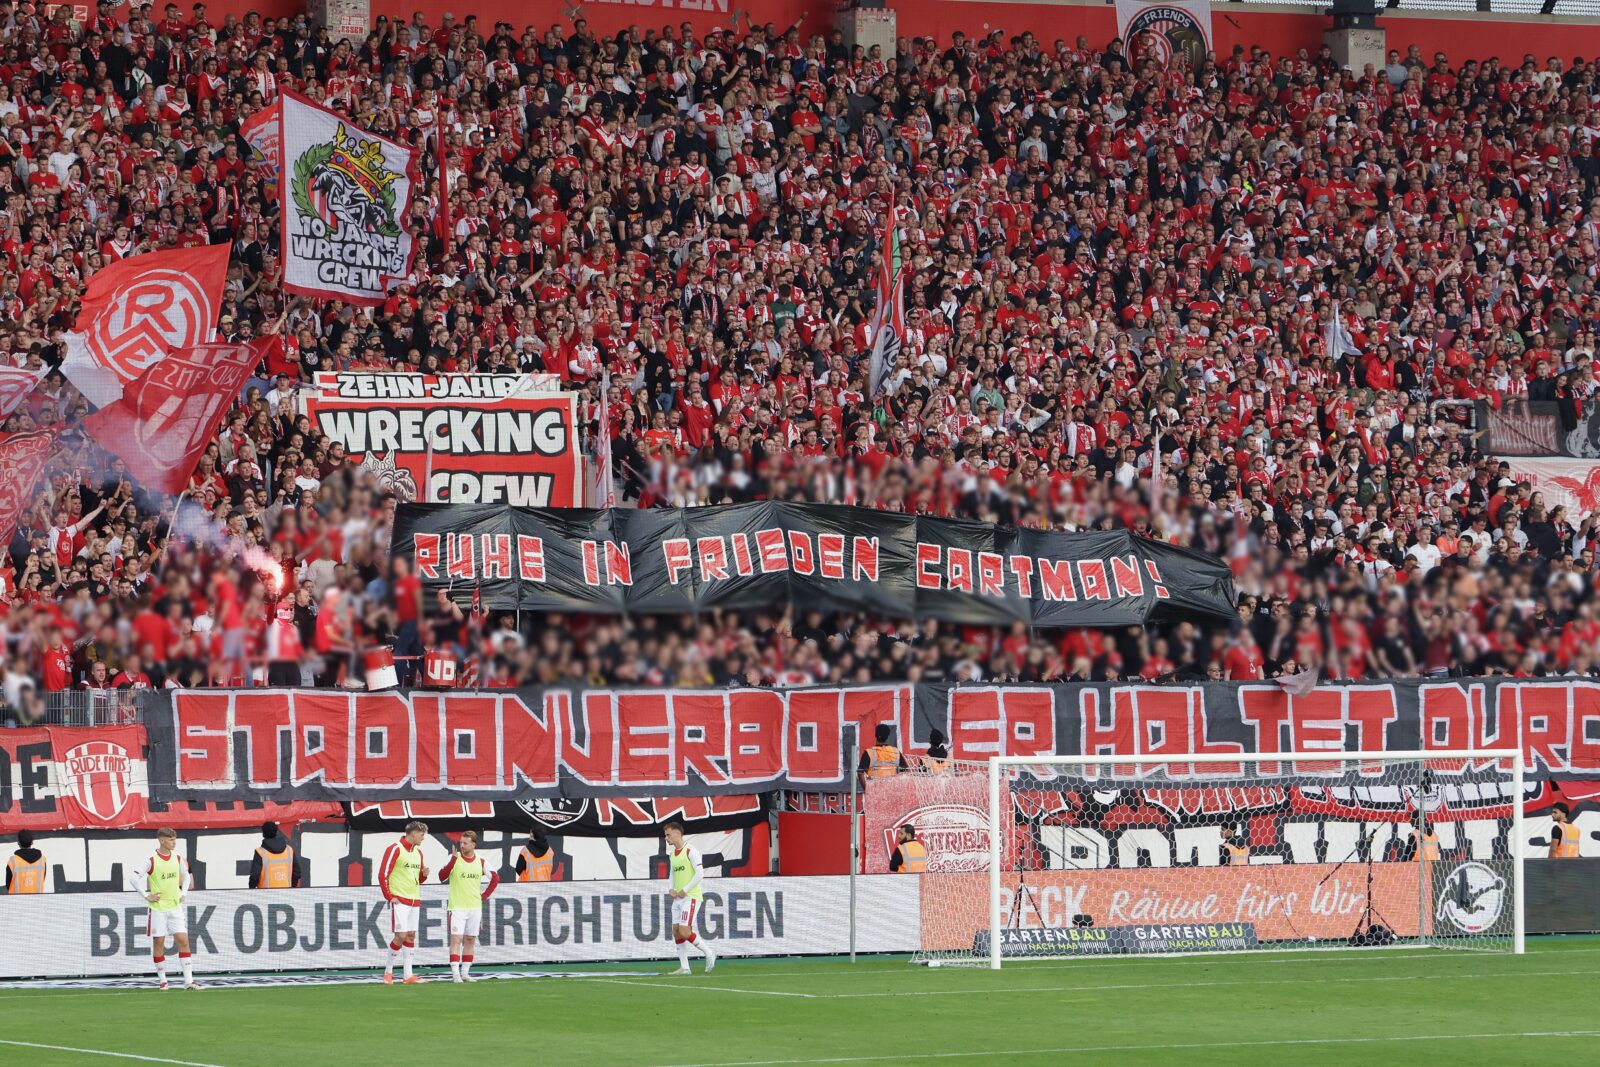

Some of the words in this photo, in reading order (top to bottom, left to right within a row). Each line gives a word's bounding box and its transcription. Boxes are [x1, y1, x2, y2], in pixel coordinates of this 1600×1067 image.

[1144, 9, 1191, 27] FRIENDS
[300, 215, 326, 237] 10
[292, 234, 404, 273] WRECKING
[318, 260, 387, 291] CREW
[315, 407, 566, 456] WRECKING
[430, 472, 554, 507] CREW
[414, 532, 546, 582] RUHE
[581, 540, 634, 587] IN
[662, 527, 879, 585] FRIEDEN
[916, 542, 1170, 602] CARTMAN!
[70, 756, 101, 775] RUDE
[104, 755, 127, 772] FANS
[1109, 889, 1219, 921] Räume
[91, 905, 219, 957] BEK
[1135, 925, 1244, 940] GARTENBAU
[1168, 940, 1193, 948] NACH
